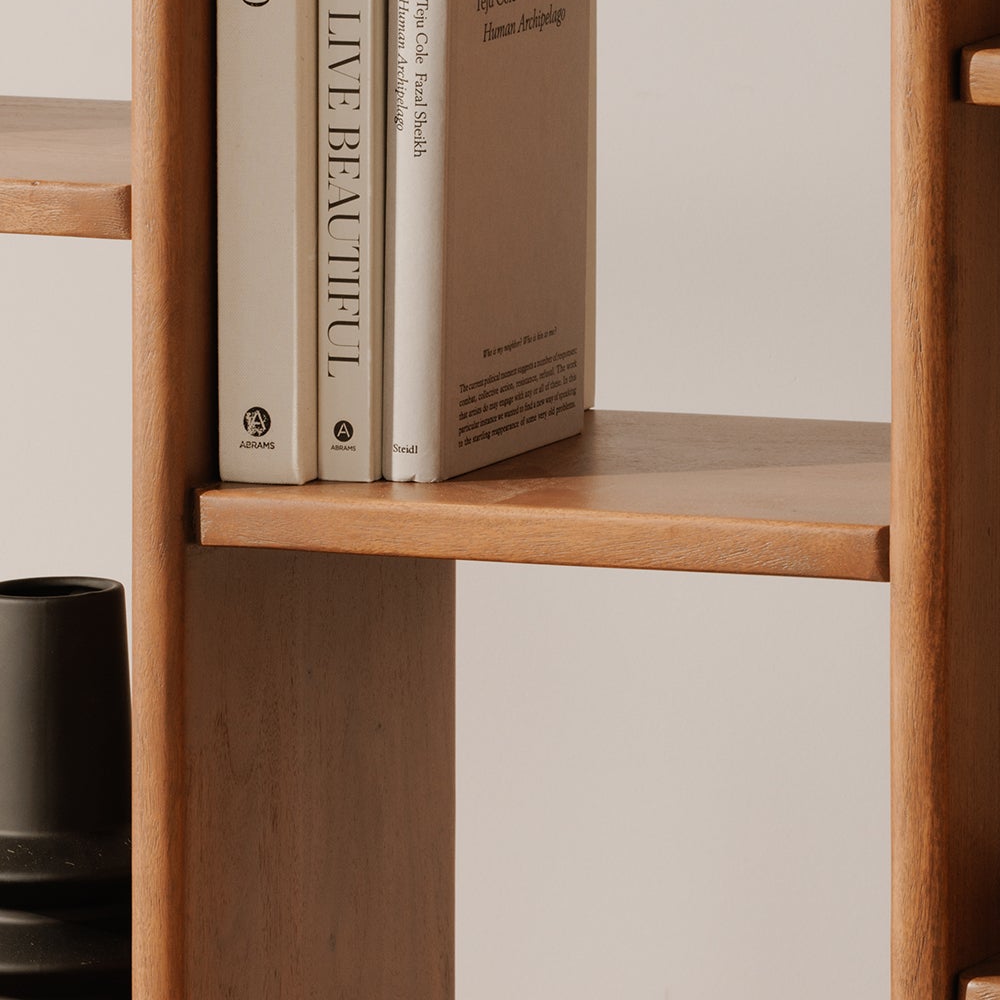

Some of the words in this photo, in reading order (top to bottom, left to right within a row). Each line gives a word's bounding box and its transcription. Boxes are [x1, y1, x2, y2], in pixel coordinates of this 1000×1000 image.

[398, 0, 409, 49] Human
[413, 0, 429, 28] Teju
[483, 21, 517, 42] Human
[517, 4, 566, 32] Archipelago
[328, 10, 361, 110] LIVE
[415, 32, 429, 64] Cole
[394, 53, 409, 131] Archipelago
[414, 73, 428, 107] Fazal
[413, 111, 427, 158] Sheikh
[327, 124, 361, 378] BEAUTIFUL
[239, 440, 275, 450] ABRAMS
[330, 444, 357, 452] ABRAMS
[393, 444, 418, 454] Steidl
